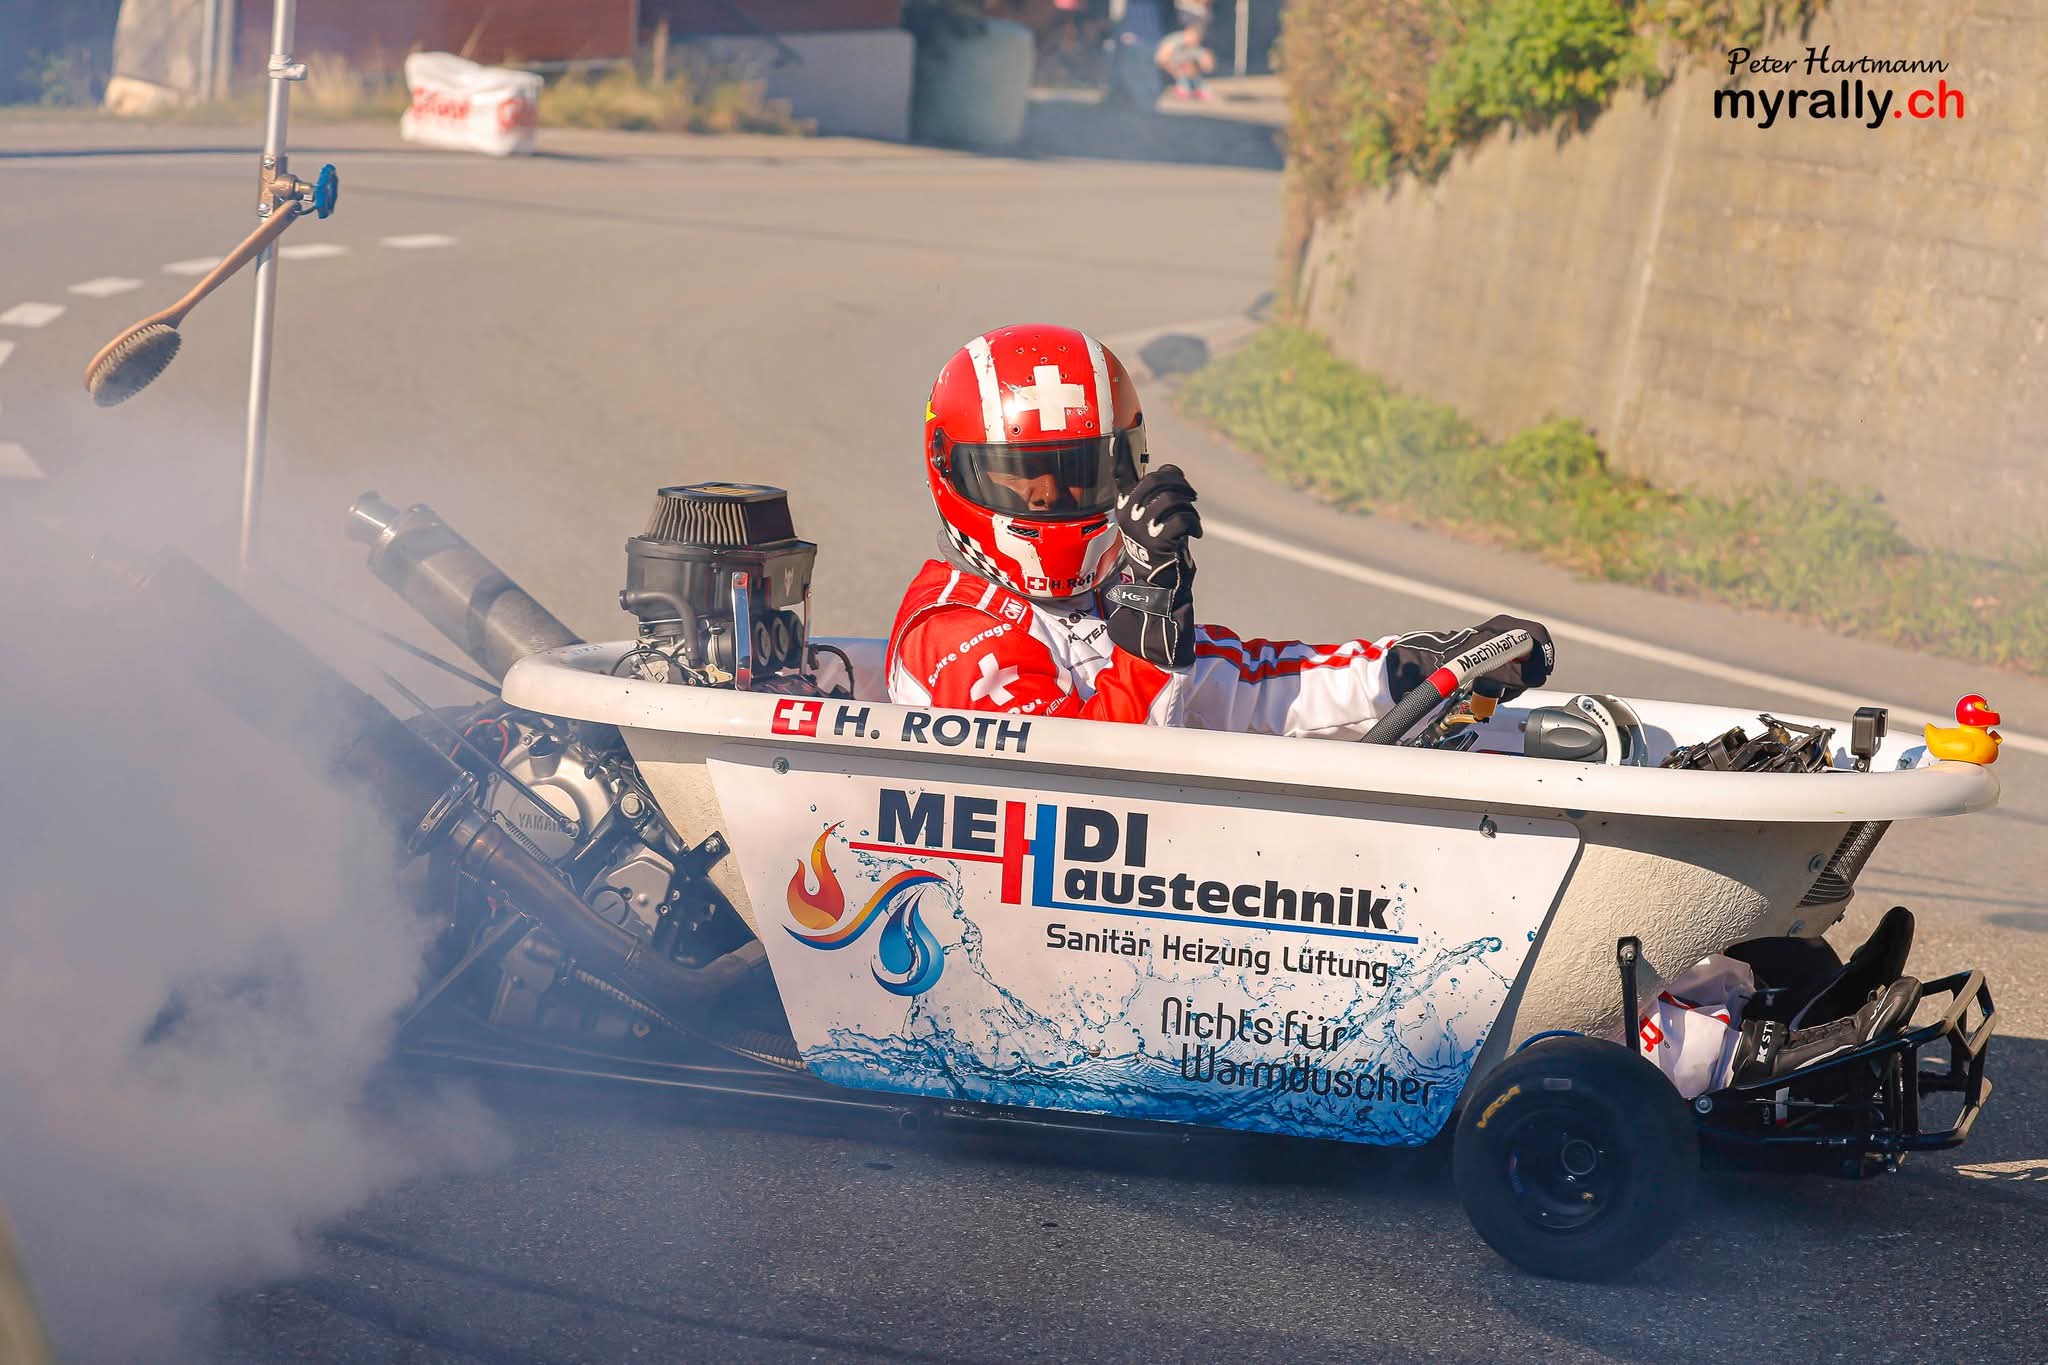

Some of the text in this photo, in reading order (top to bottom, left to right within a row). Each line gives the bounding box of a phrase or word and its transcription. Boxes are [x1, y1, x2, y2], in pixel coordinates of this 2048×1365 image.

[959, 622, 1012, 654] Garage
[834, 705, 1032, 753] H. ROTH
[1046, 923, 1388, 987] Sanitär Heizung Lüftung
[1161, 997, 1346, 1052] Nichts für
[1181, 1043, 1438, 1106] Warmduscher
